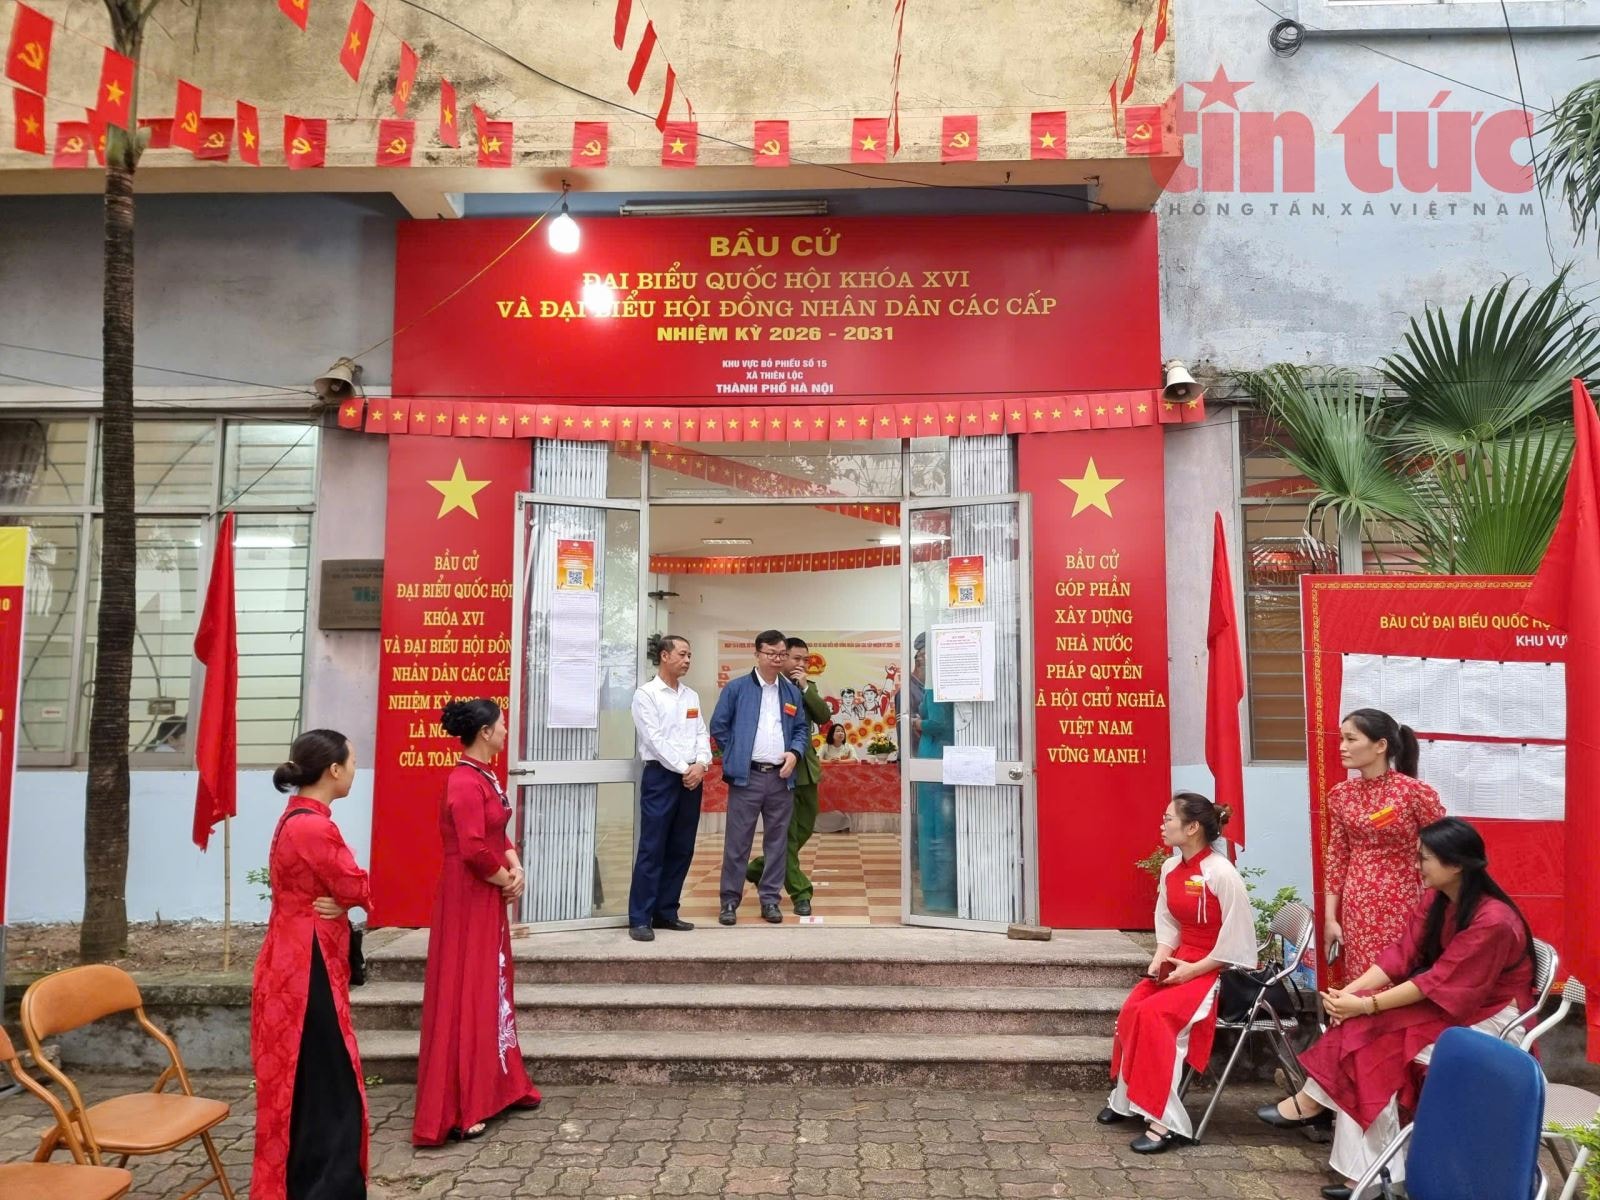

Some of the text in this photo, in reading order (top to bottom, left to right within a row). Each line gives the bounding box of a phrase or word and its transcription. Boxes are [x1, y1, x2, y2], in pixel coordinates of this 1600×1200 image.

[710, 227, 841, 257] BẦU CỬ
[637, 261, 698, 290] BIỂU
[705, 265, 777, 290] QUỐC
[784, 266, 832, 293] HỘI
[839, 266, 914, 289] KHÓA
[922, 270, 970, 288] XVI
[496, 289, 1057, 322] VÀ ĐẠI IỂU HỘI ĐỒNG NHÂN DÂN CÁC CẤP
[657, 325, 728, 343] NHIỆM
[735, 325, 763, 341] KỲ
[769, 327, 822, 341] 2026
[843, 326, 894, 341] 2031
[722, 359, 740, 368] KHU
[742, 359, 759, 369] VỰC
[775, 358, 800, 368] PHIẾU
[803, 358, 815, 368] SỐ
[817, 360, 828, 368] 15
[760, 370, 785, 380] THIÊN
[788, 370, 804, 381] LỘC
[716, 381, 834, 395] THÀNH PHỐ HÀ NỘI
[434, 548, 481, 571] BẦU CỬ
[1065, 547, 1120, 569] BẦU CỬ
[396, 583, 420, 602] ĐẠI
[422, 574, 452, 598] BIỂU
[454, 576, 489, 599] QUỐC
[490, 579, 513, 602] HỘI
[1055, 574, 1131, 597] GÓP PHẦN
[423, 607, 485, 626] KHÓA XVI
[1055, 605, 1133, 628] XÂY DỰNG
[1380, 613, 1407, 628] BẦU
[1410, 612, 1430, 629] CỬ
[1432, 616, 1455, 631] ĐẠI
[1491, 612, 1529, 630] QUỐC
[384, 630, 512, 658] VÀ ĐẠI BIỂU HỘI ĐỒN
[1056, 633, 1133, 652] NHÀ NƯỚC
[1516, 633, 1568, 649] KHU VỰ
[392, 660, 511, 682] NHÂN DÂN CÁC CẤP
[1046, 657, 1143, 680] PHÁP QUYỀN
[388, 690, 431, 714] NHIỆM
[1051, 688, 1078, 710] HỘI
[1082, 685, 1112, 707] CHỦ
[1117, 689, 1167, 708] NGHĨA
[409, 719, 426, 738] LÀ
[1059, 715, 1133, 739] VIỆT NAM
[399, 745, 425, 767] CỦA
[428, 747, 462, 767] TOÀN
[1048, 744, 1089, 763] VỮNG
